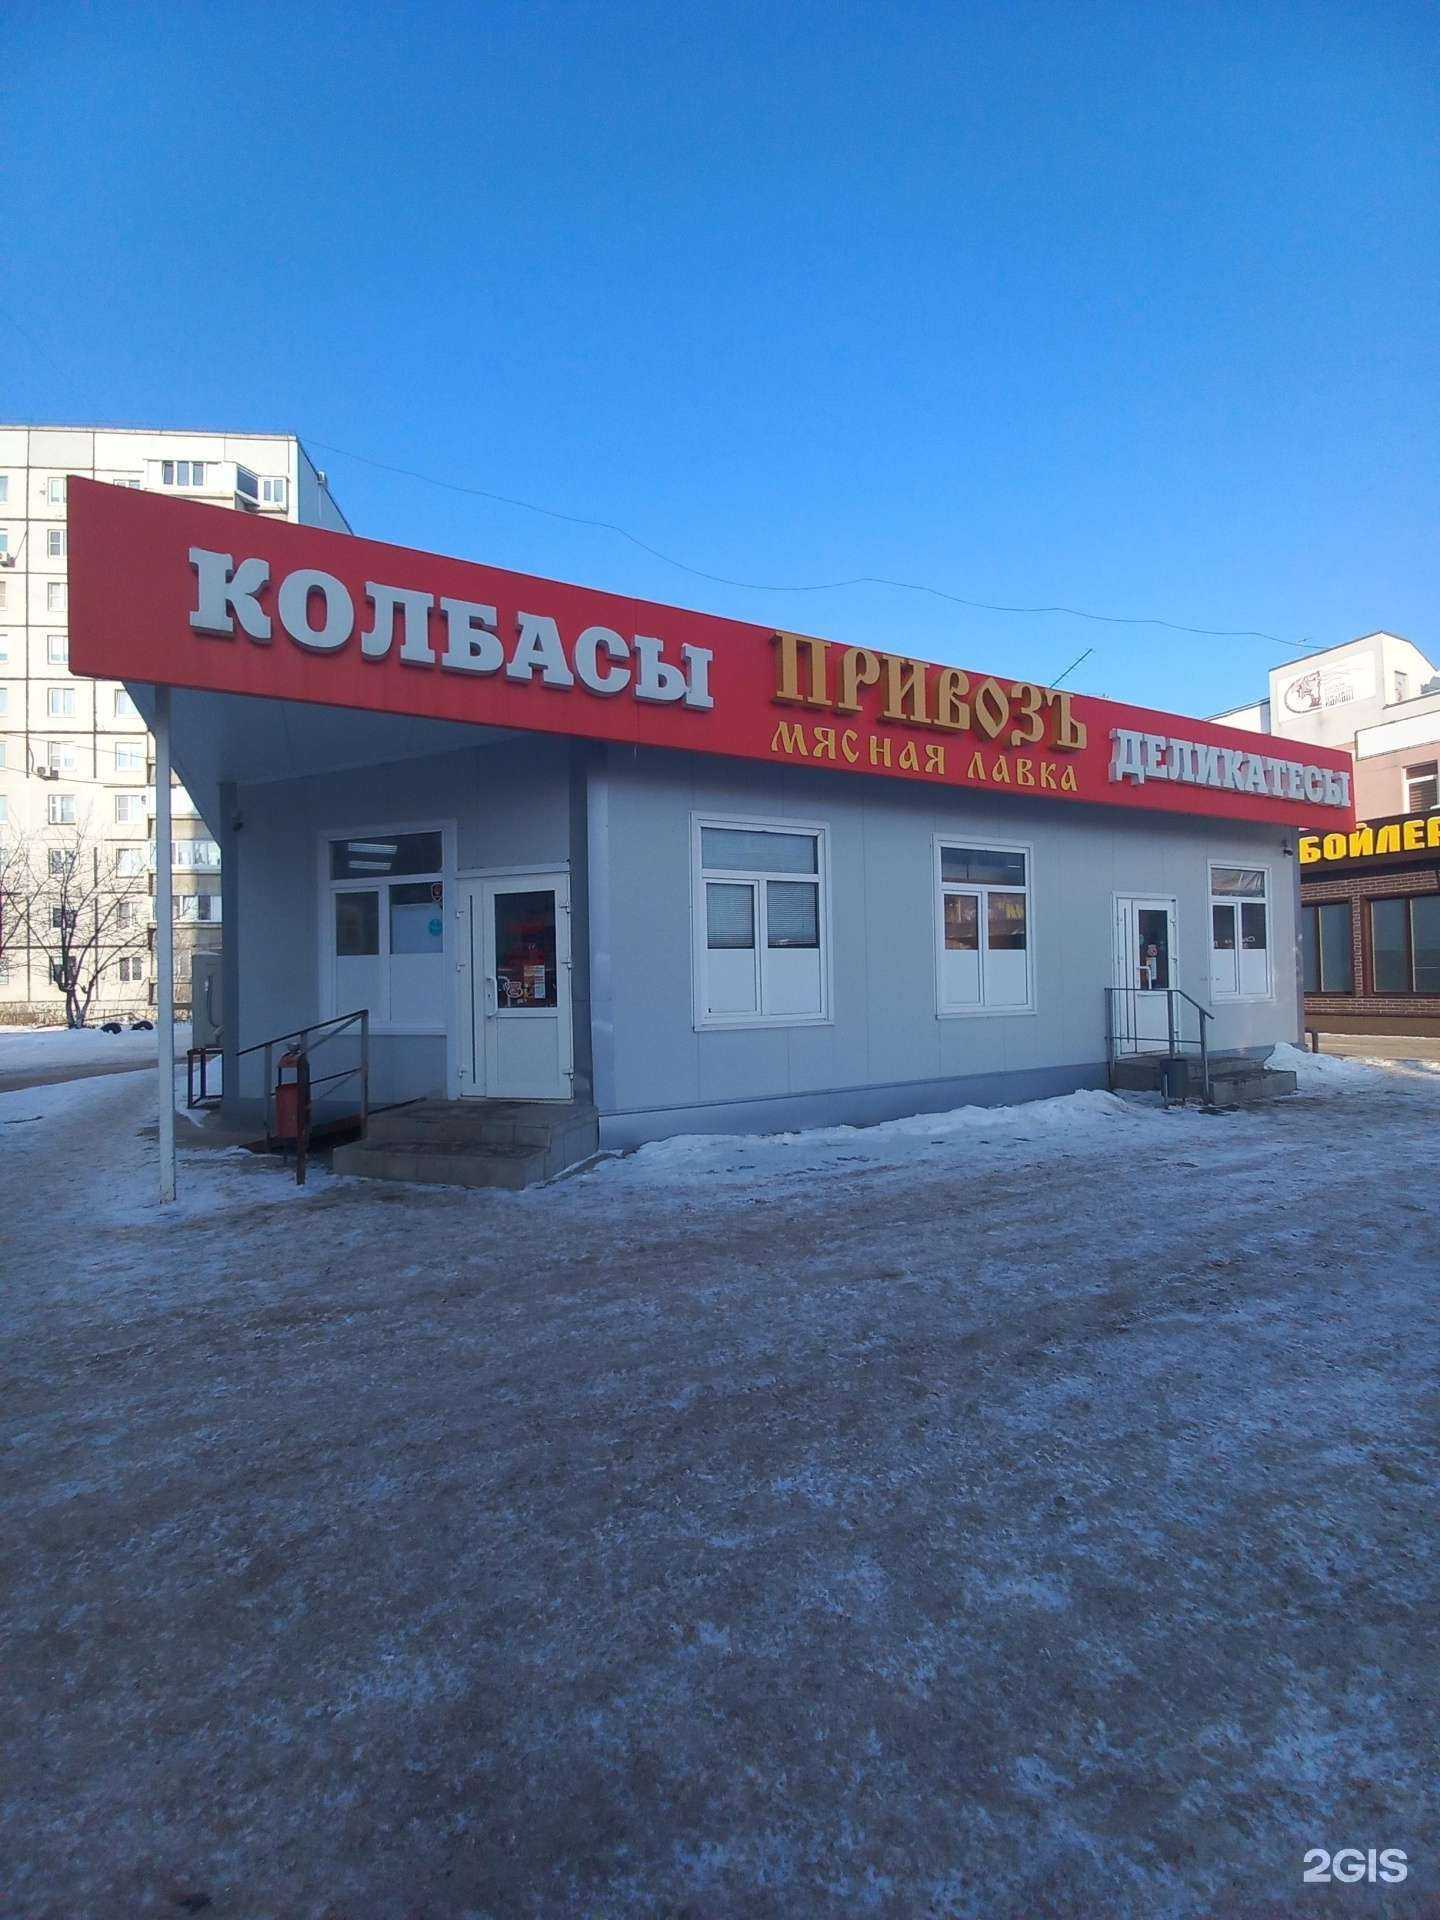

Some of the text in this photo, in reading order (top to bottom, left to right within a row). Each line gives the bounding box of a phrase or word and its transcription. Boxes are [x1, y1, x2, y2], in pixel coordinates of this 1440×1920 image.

[188, 546, 714, 709] КОЛБАСЫ
[771, 630, 1087, 750] ПРИВОЗЪ
[771, 720, 1078, 792] МЯСНАЯ ЛАВКА
[1108, 727, 1351, 808] ДЕЛИКАТЕСЫ
